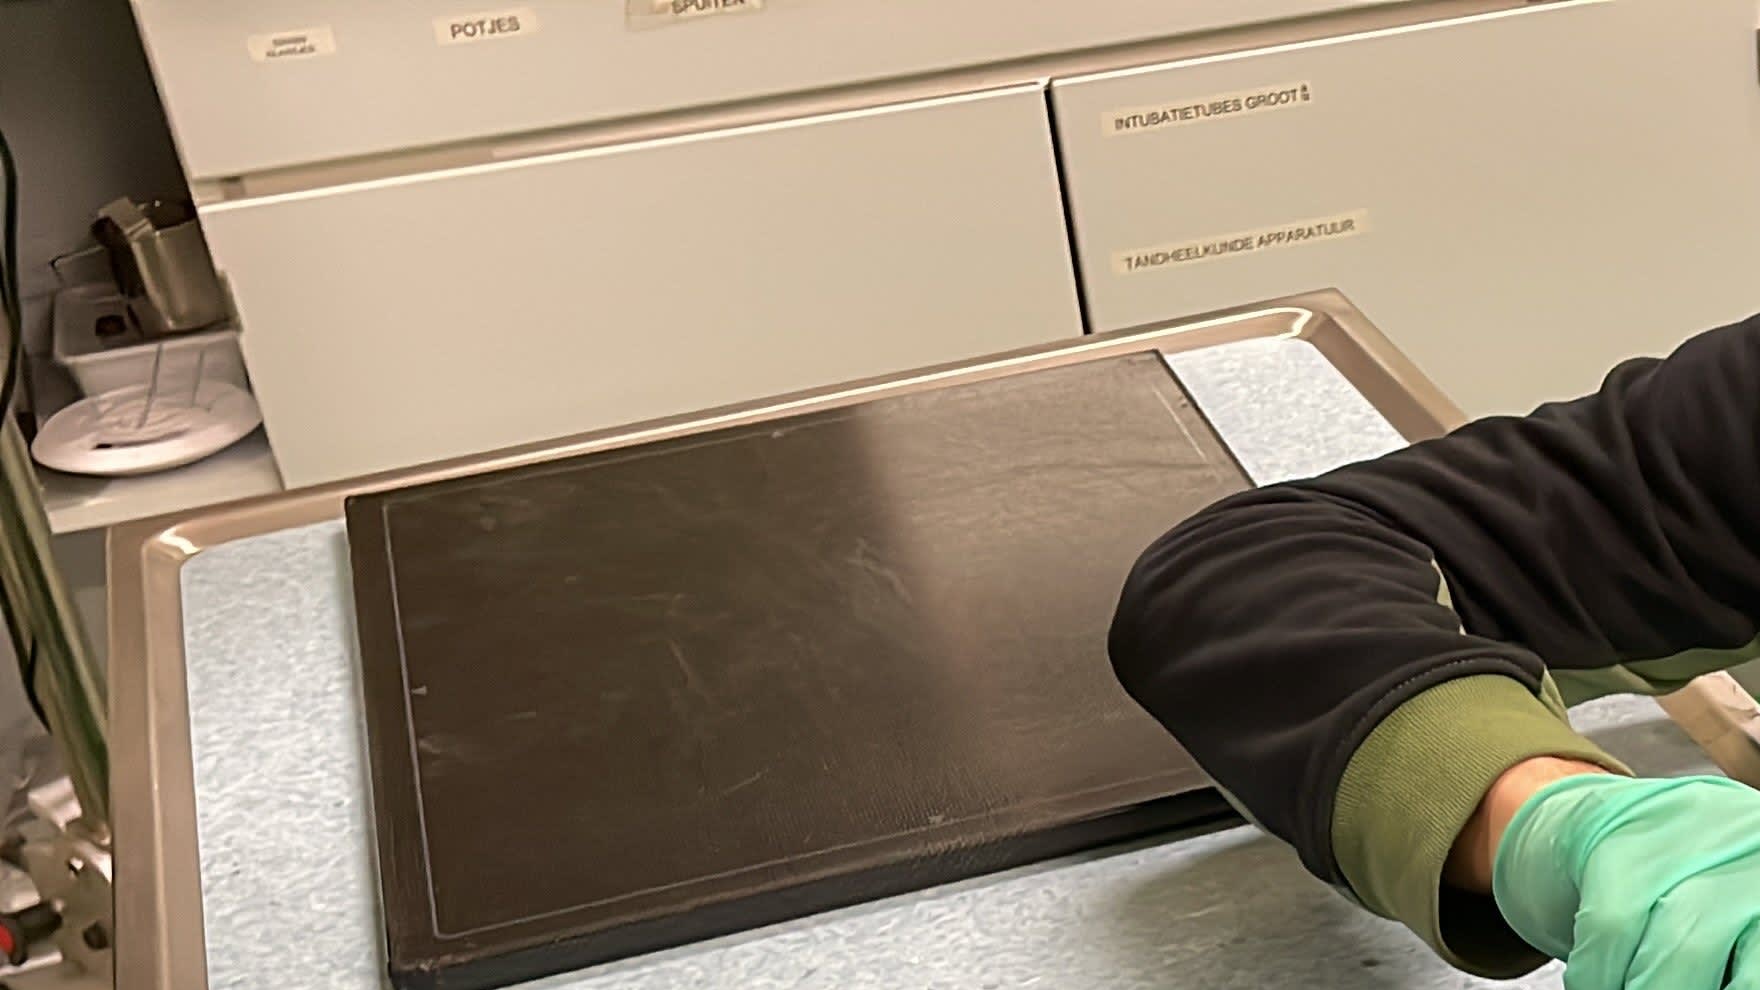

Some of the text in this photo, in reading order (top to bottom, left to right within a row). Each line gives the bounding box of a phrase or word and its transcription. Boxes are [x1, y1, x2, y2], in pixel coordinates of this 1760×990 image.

[450, 16, 520, 39] POTJES
[1114, 98, 1242, 130] INTUBATIETUBES
[1244, 89, 1298, 110] GROOT
[1124, 219, 1355, 271] TANDHEELKUNDE APPARATUUR
